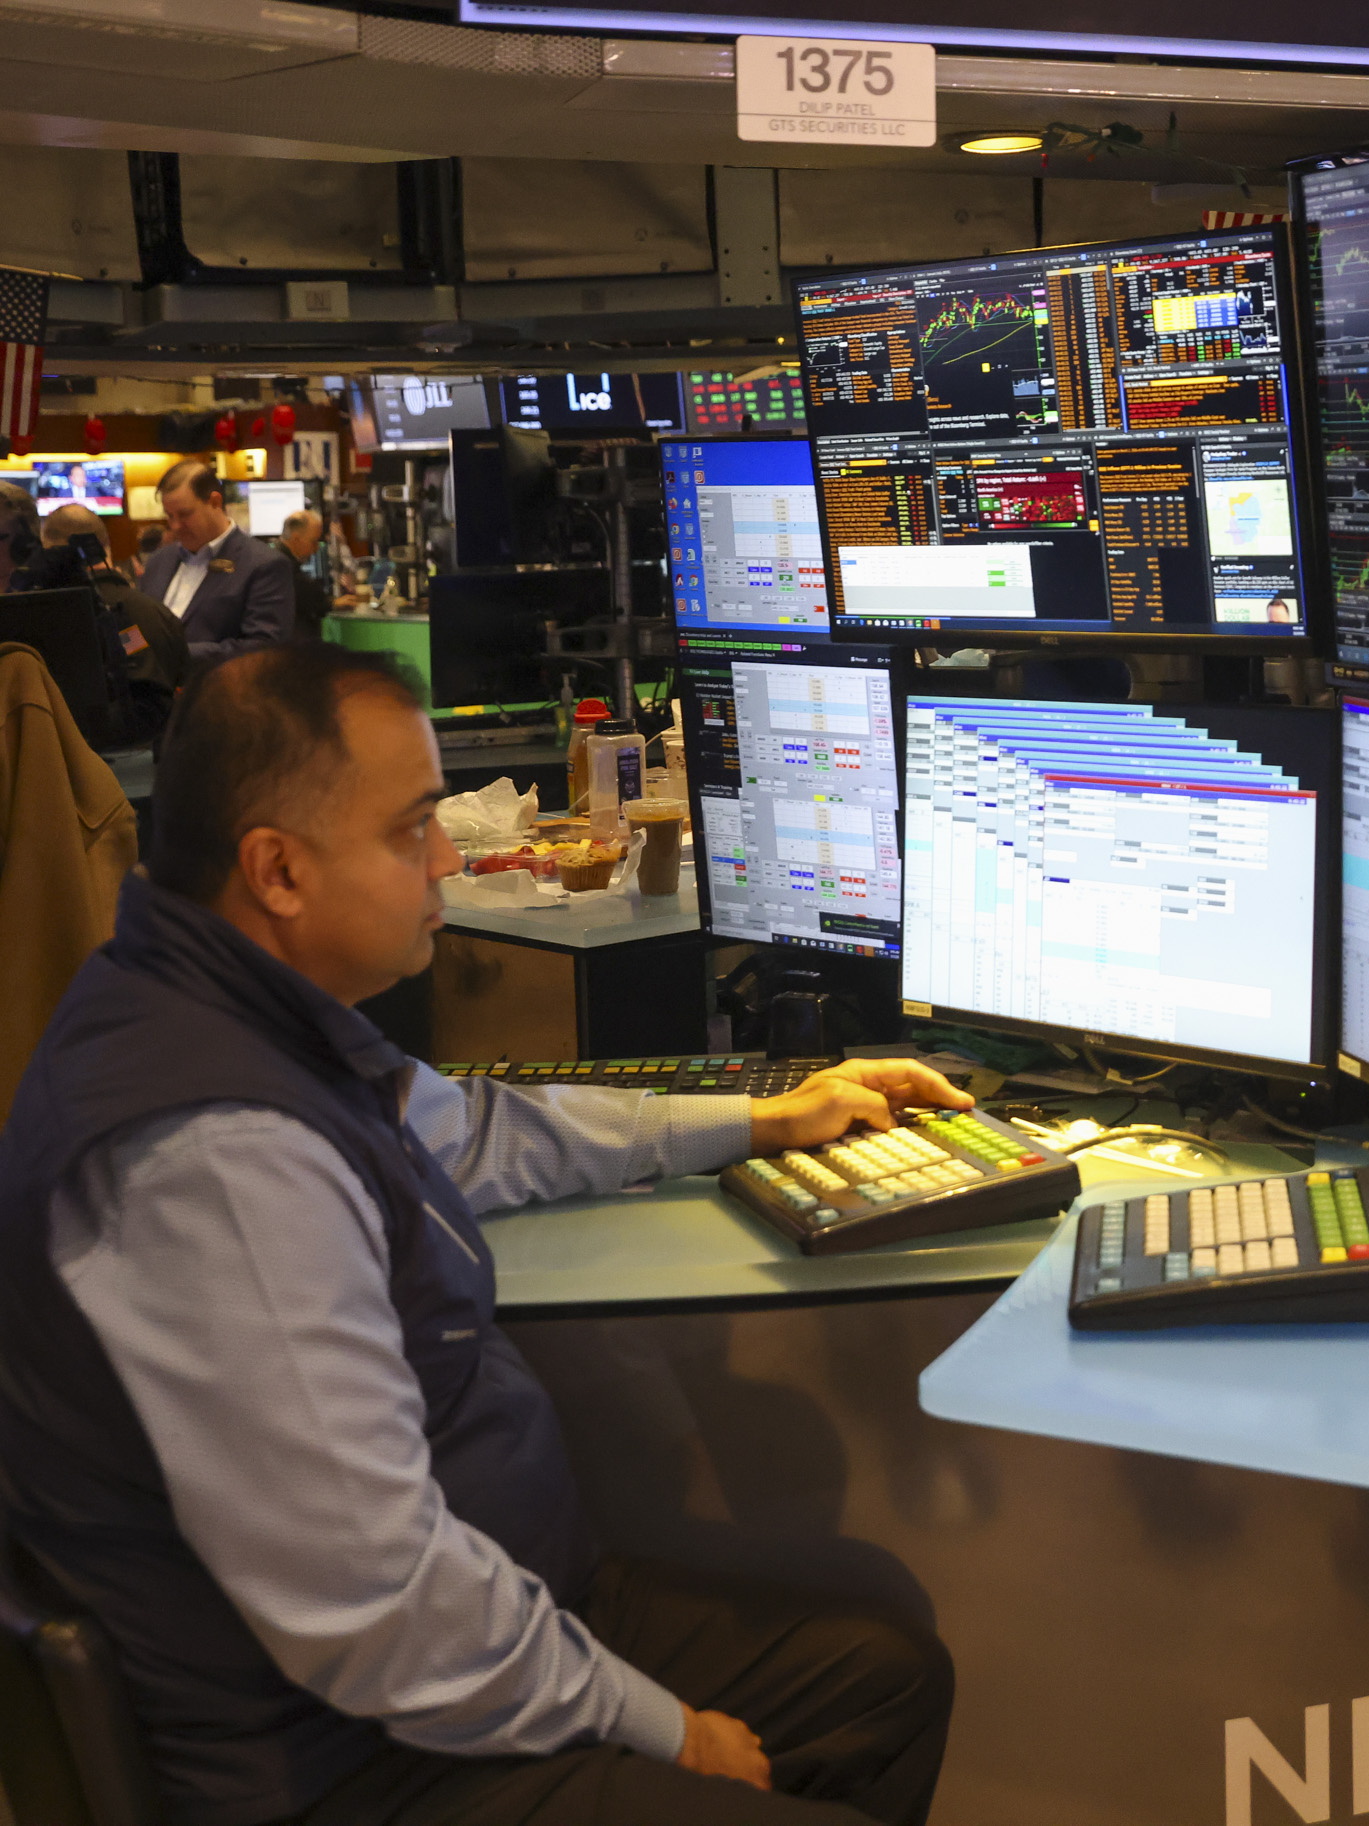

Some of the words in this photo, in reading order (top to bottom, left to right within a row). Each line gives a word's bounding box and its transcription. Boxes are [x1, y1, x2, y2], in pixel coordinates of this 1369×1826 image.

[776, 46, 895, 96] 1375
[799, 101, 833, 115] DILIP
[836, 102, 875, 116] PATEL
[768, 118, 796, 132] GTS
[799, 120, 877, 135] SECURITIES
[881, 124, 906, 136] LLC
